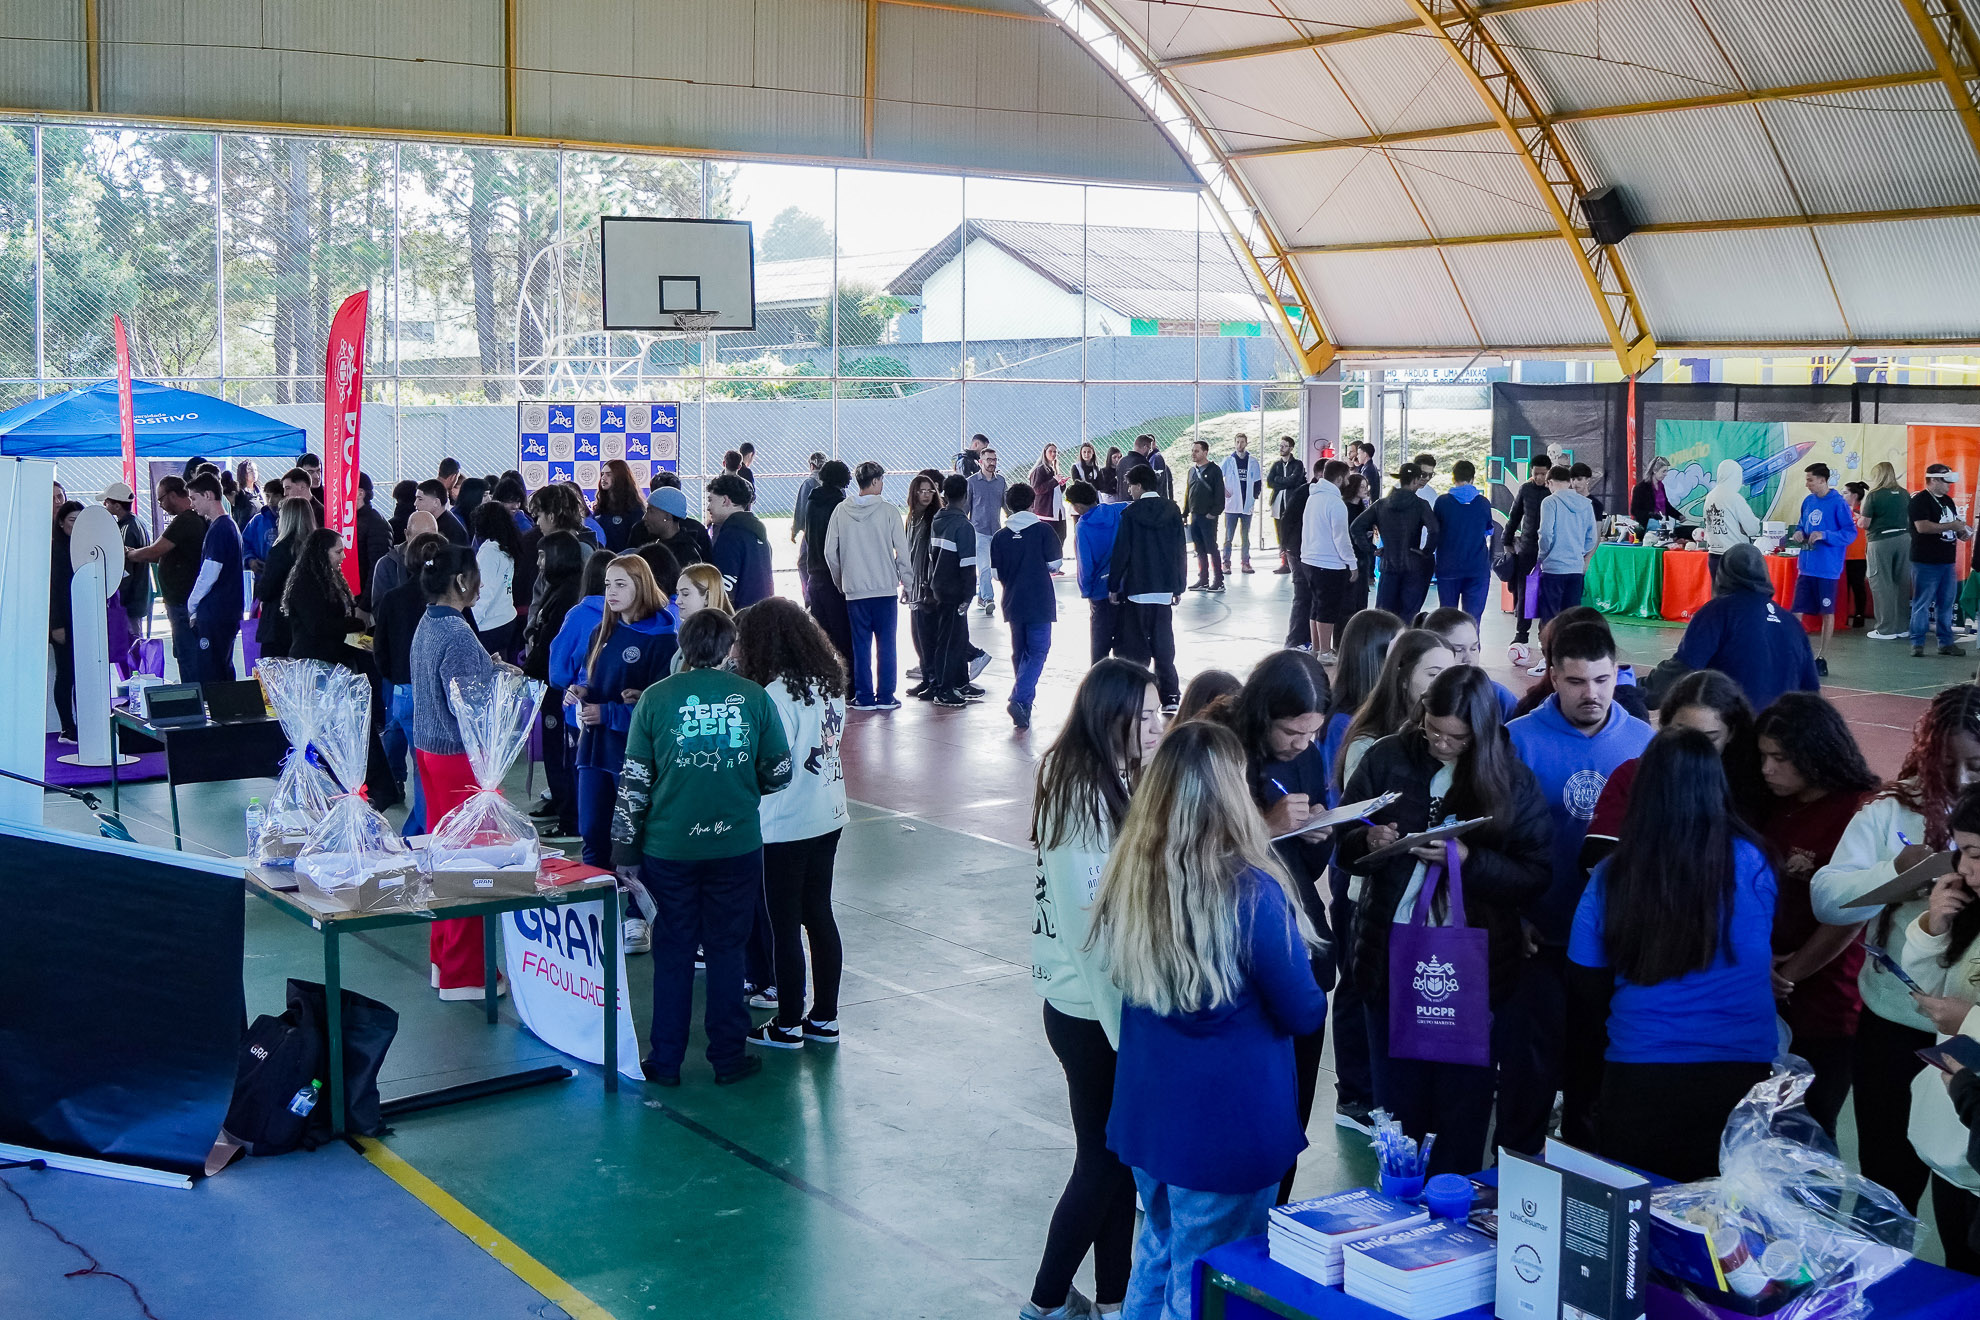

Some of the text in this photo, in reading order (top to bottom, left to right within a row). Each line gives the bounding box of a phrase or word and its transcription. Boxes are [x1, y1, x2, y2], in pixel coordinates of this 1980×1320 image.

[134, 412, 167, 420] versidade
[134, 412, 199, 425] OSITIVO
[331, 478, 339, 532] MARIS
[689, 820, 733, 836] Ana Bia
[1416, 1005, 1456, 1017] PUCPR
[1279, 1189, 1371, 1216] UniCesumar
[1509, 1210, 1549, 1232] UniCesumar
[1351, 1221, 1448, 1251] UniCesumar
[1625, 1219, 1641, 1300] Gastronomia
